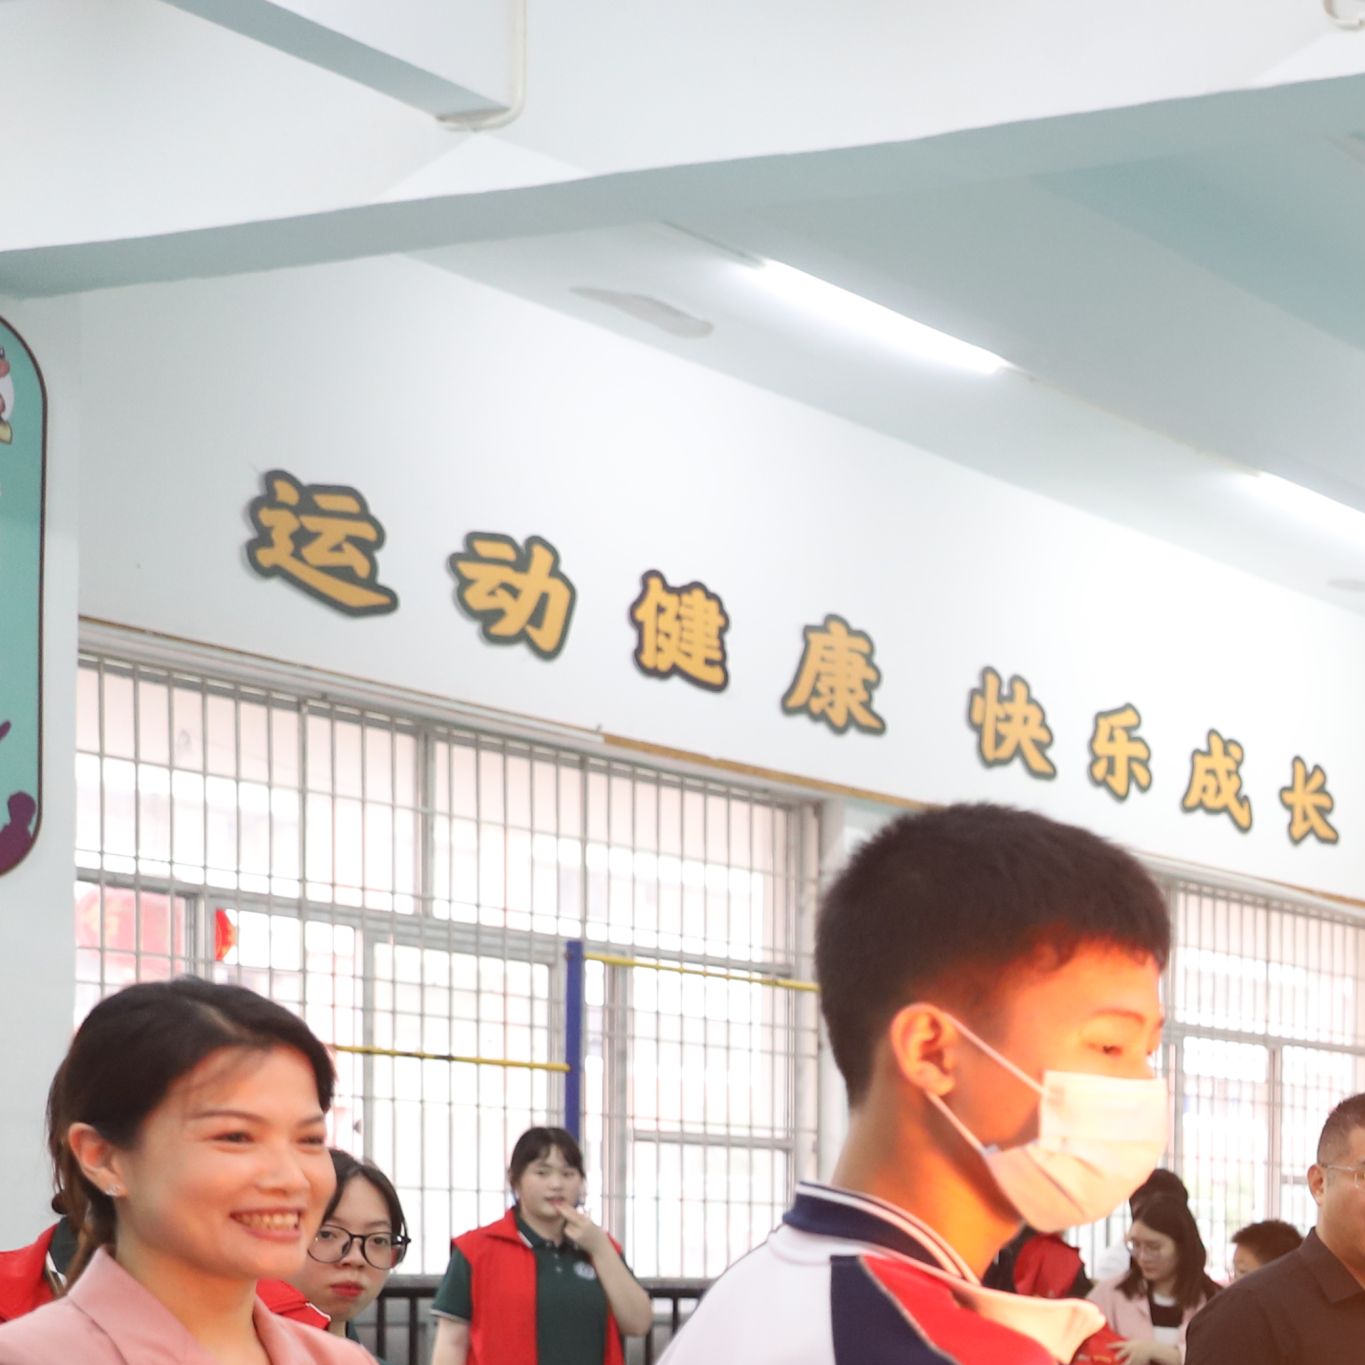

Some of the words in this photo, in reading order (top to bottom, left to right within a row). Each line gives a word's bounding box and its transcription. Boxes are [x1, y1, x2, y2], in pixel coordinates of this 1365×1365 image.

[245, 469, 886, 735] 运动健康
[968, 666, 1339, 844] 快乐成长
